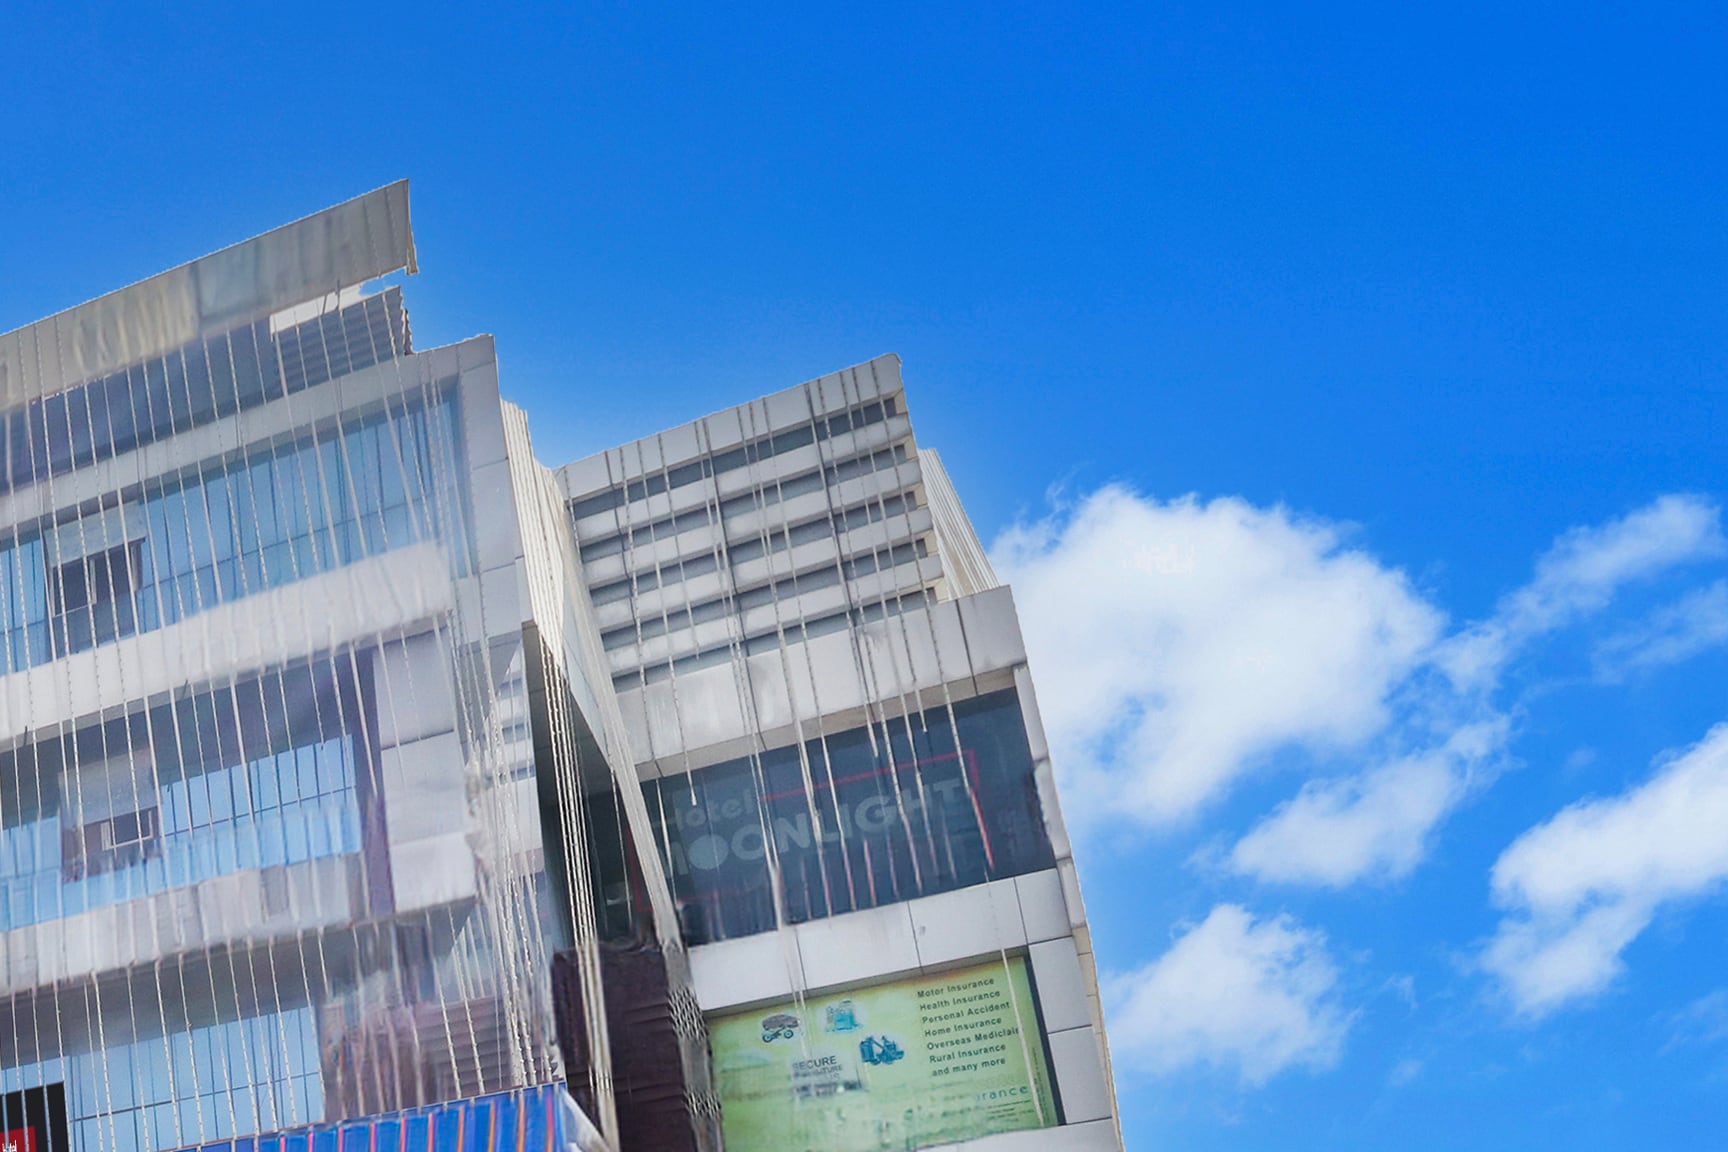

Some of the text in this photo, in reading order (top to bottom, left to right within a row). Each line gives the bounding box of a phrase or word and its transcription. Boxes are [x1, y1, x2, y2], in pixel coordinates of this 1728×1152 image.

[917, 978, 995, 998] Motor Insurance
[919, 990, 1001, 1011] Health Insurance
[922, 1001, 1010, 1024] Personal Accident
[924, 1017, 1002, 1037] Home Insurance
[927, 1037, 972, 1050] Overseas
[929, 1044, 1006, 1063] Rural Insurance
[791, 1055, 837, 1071] SECURE
[932, 1057, 1006, 1077] and many more
